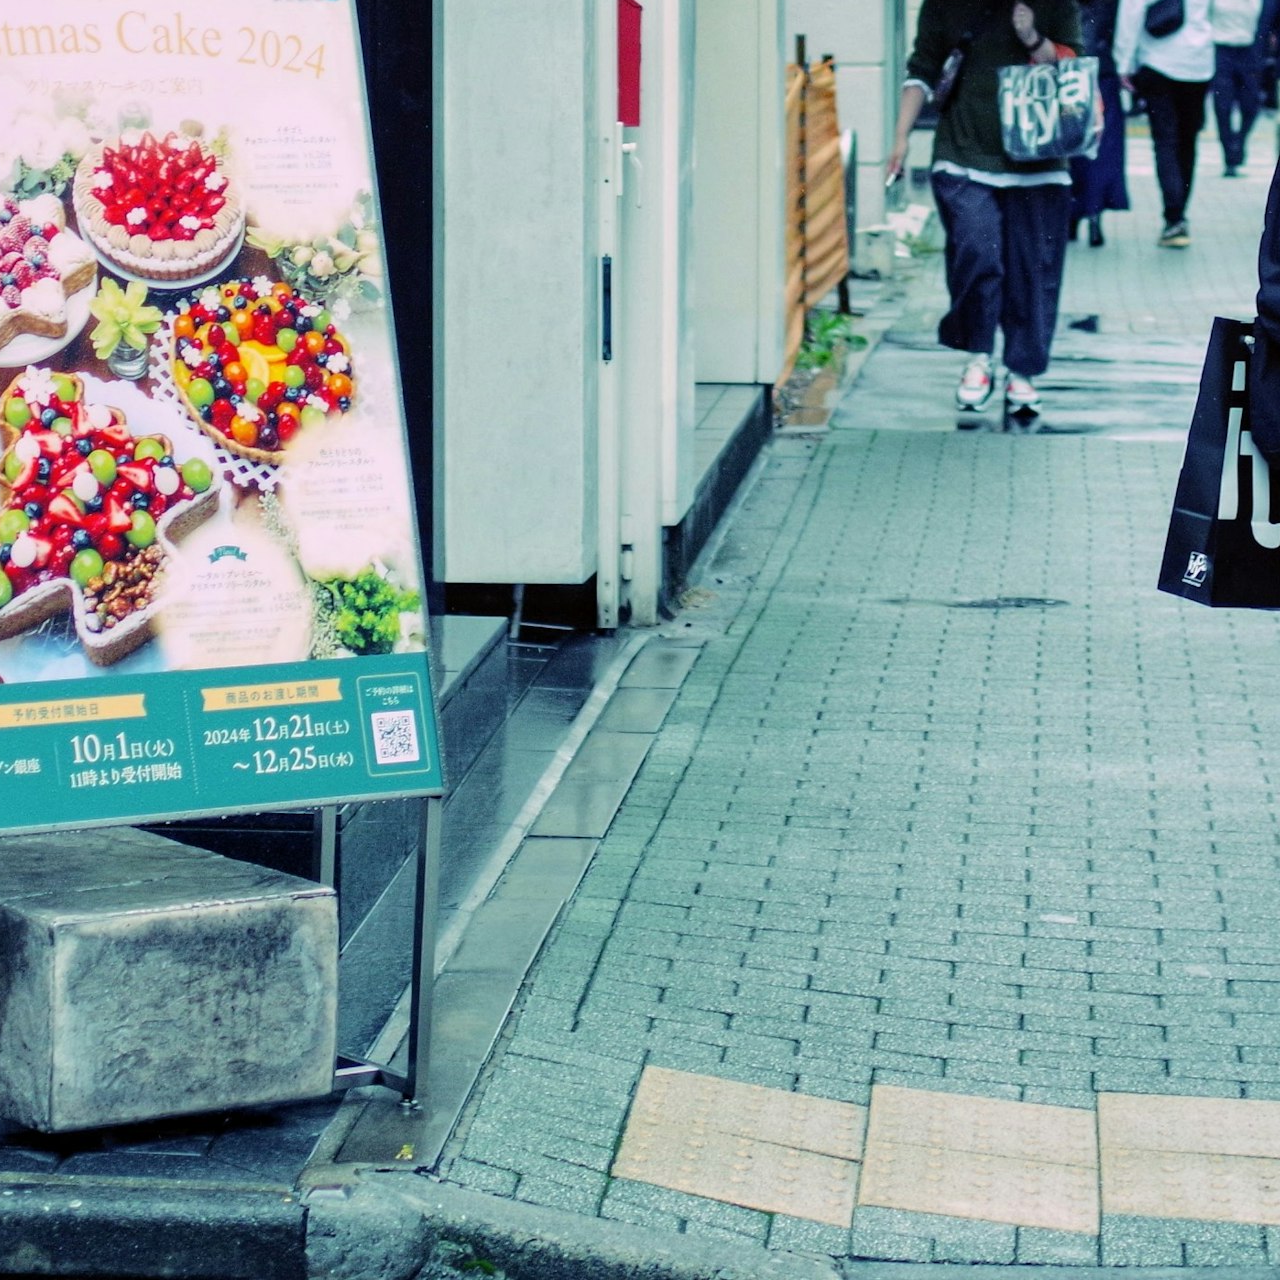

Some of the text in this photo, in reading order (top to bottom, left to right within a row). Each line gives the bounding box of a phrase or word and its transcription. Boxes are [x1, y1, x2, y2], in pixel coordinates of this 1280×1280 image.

[116, 10, 222, 58] Cake
[236, 25, 327, 79] 2024
[224, 684, 320, 705] 商品のお渡し期間
[12, 703, 100, 722] 予約受付開始日
[69, 731, 176, 765] 10月1日(火)
[70, 761, 183, 789] 11時より受付開始
